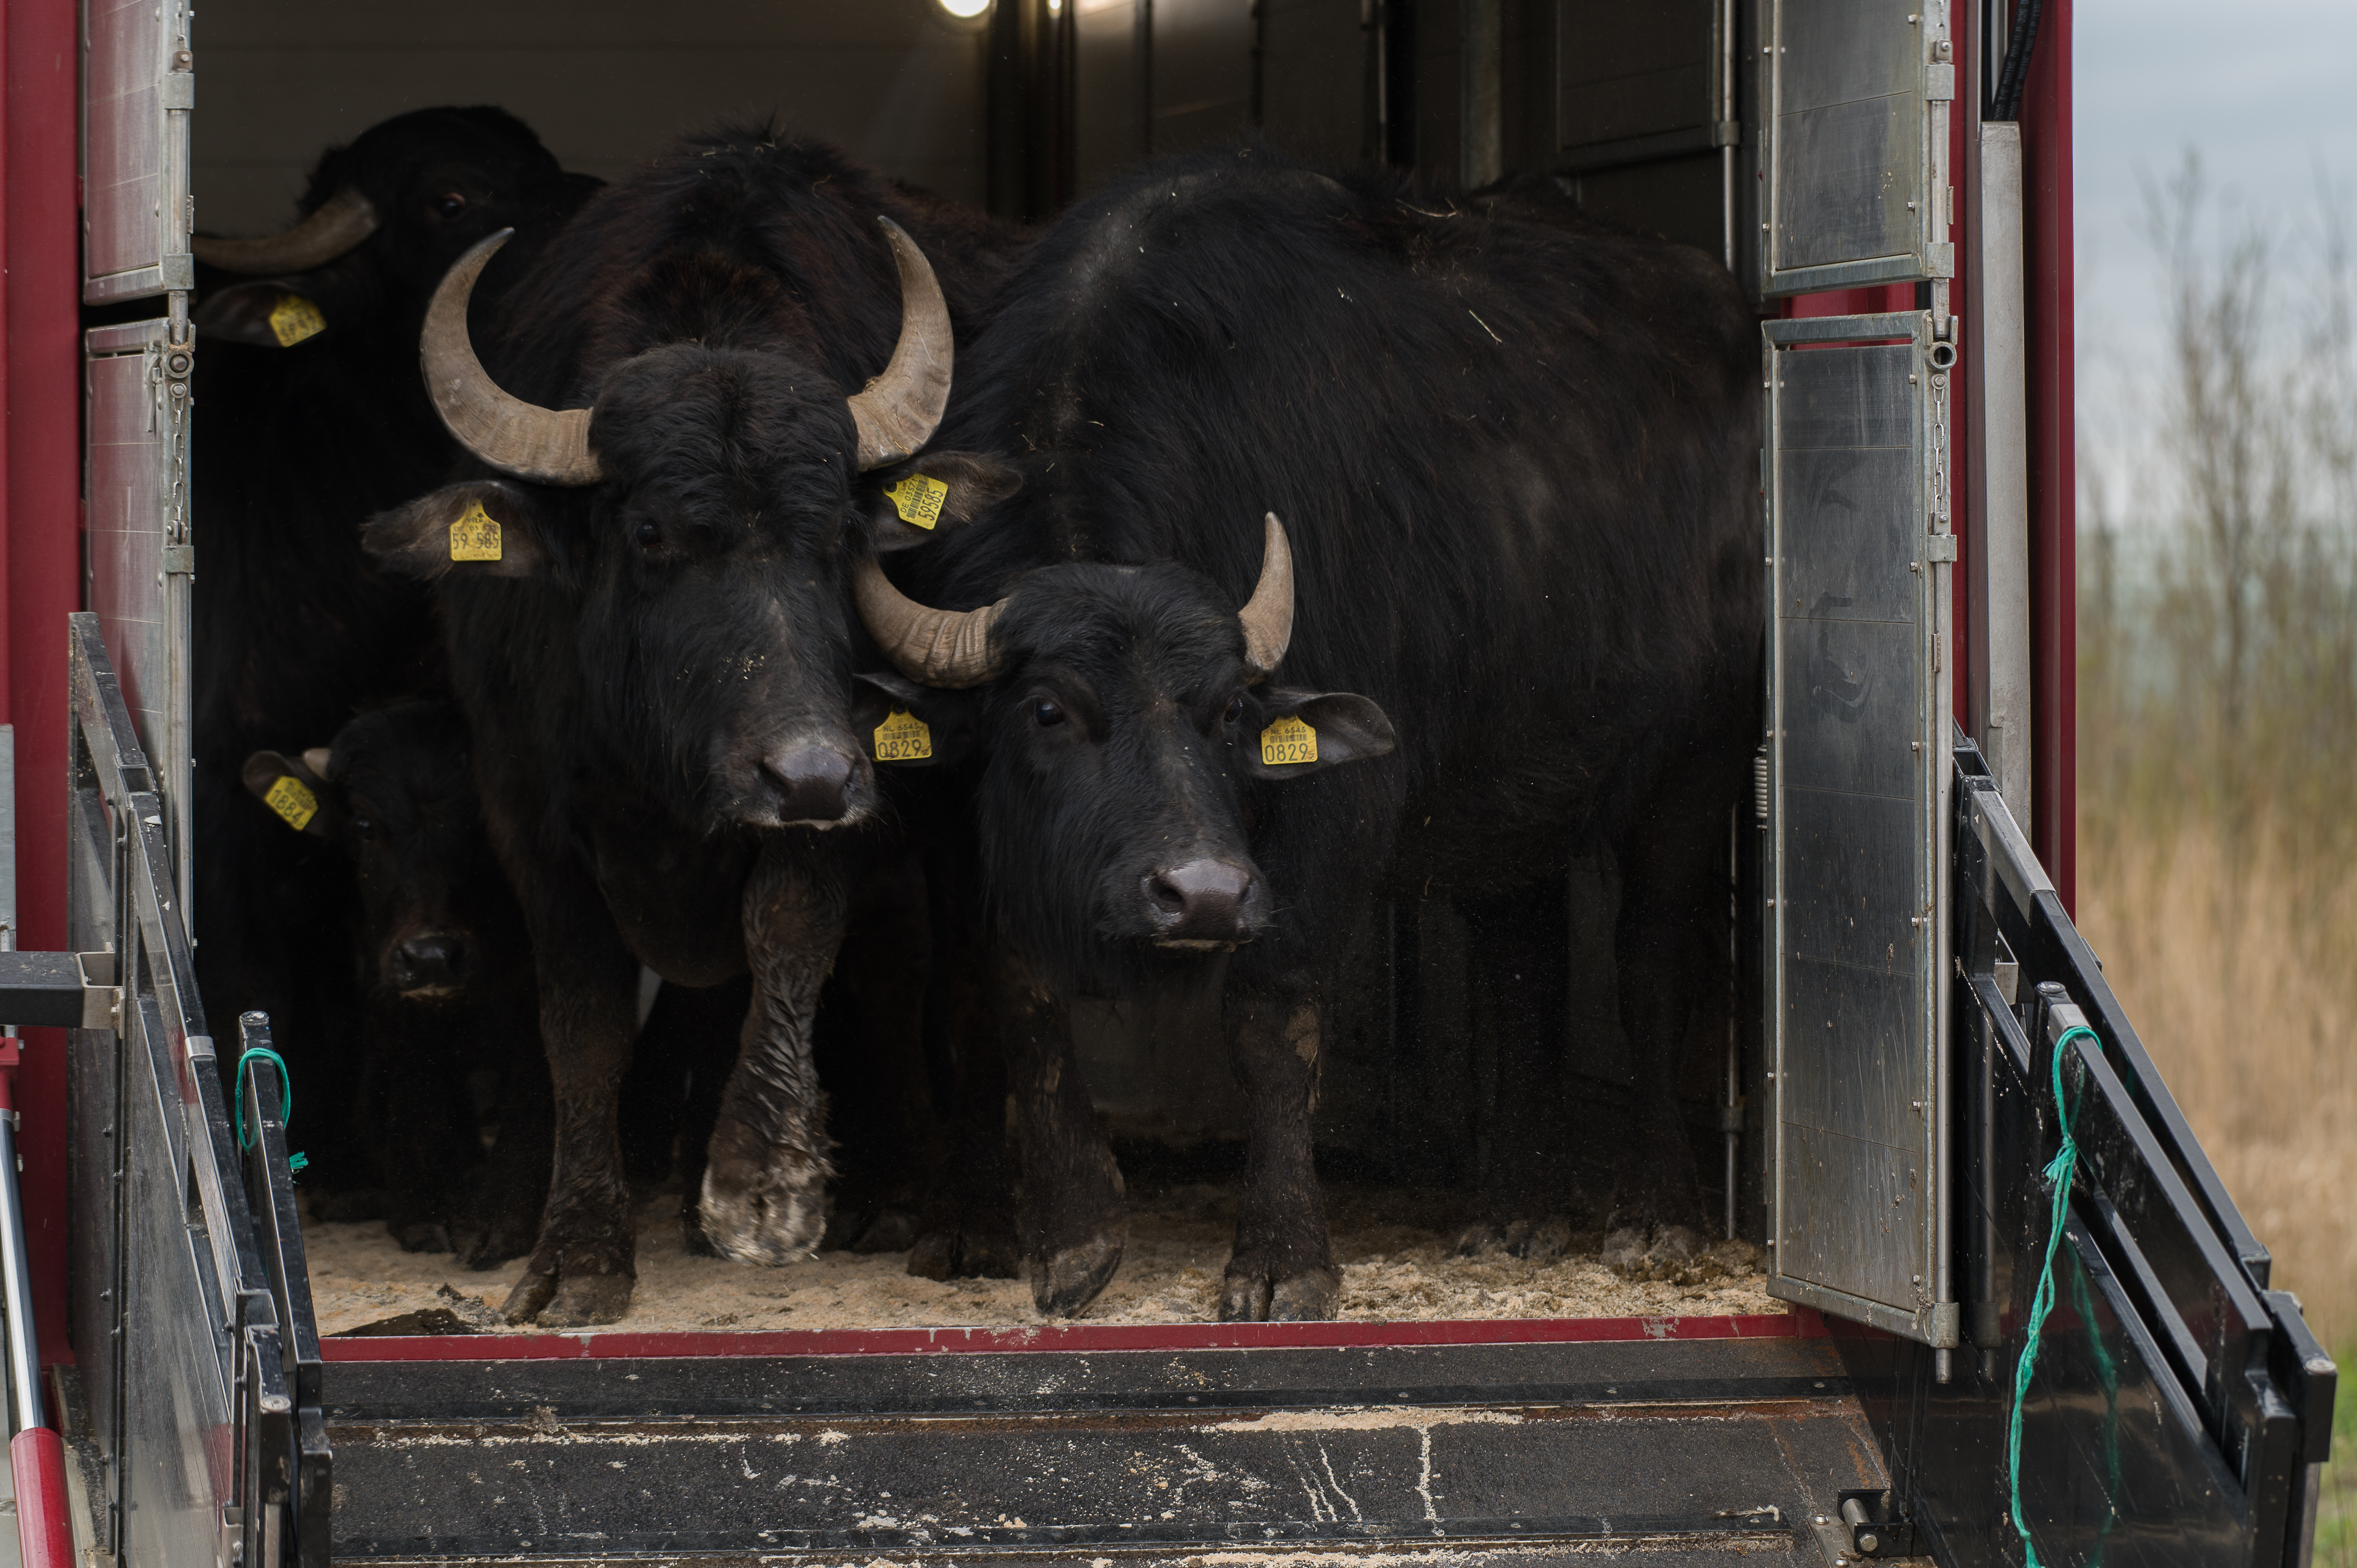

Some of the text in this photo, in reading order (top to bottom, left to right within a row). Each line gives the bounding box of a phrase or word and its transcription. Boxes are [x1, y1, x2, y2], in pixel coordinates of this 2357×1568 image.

[2002, 61, 2016, 84] MARINE
[2009, 44, 2021, 57] MAX
[2018, 55, 2030, 79] MARINE
[900, 479, 918, 513] DE 03571
[918, 487, 943, 521] 59585
[452, 532, 499, 550] 59 585
[898, 723, 919, 731] 6545
[878, 739, 921, 758] 0829
[1265, 743, 1308, 763] 0829
[271, 789, 305, 825] 1884
